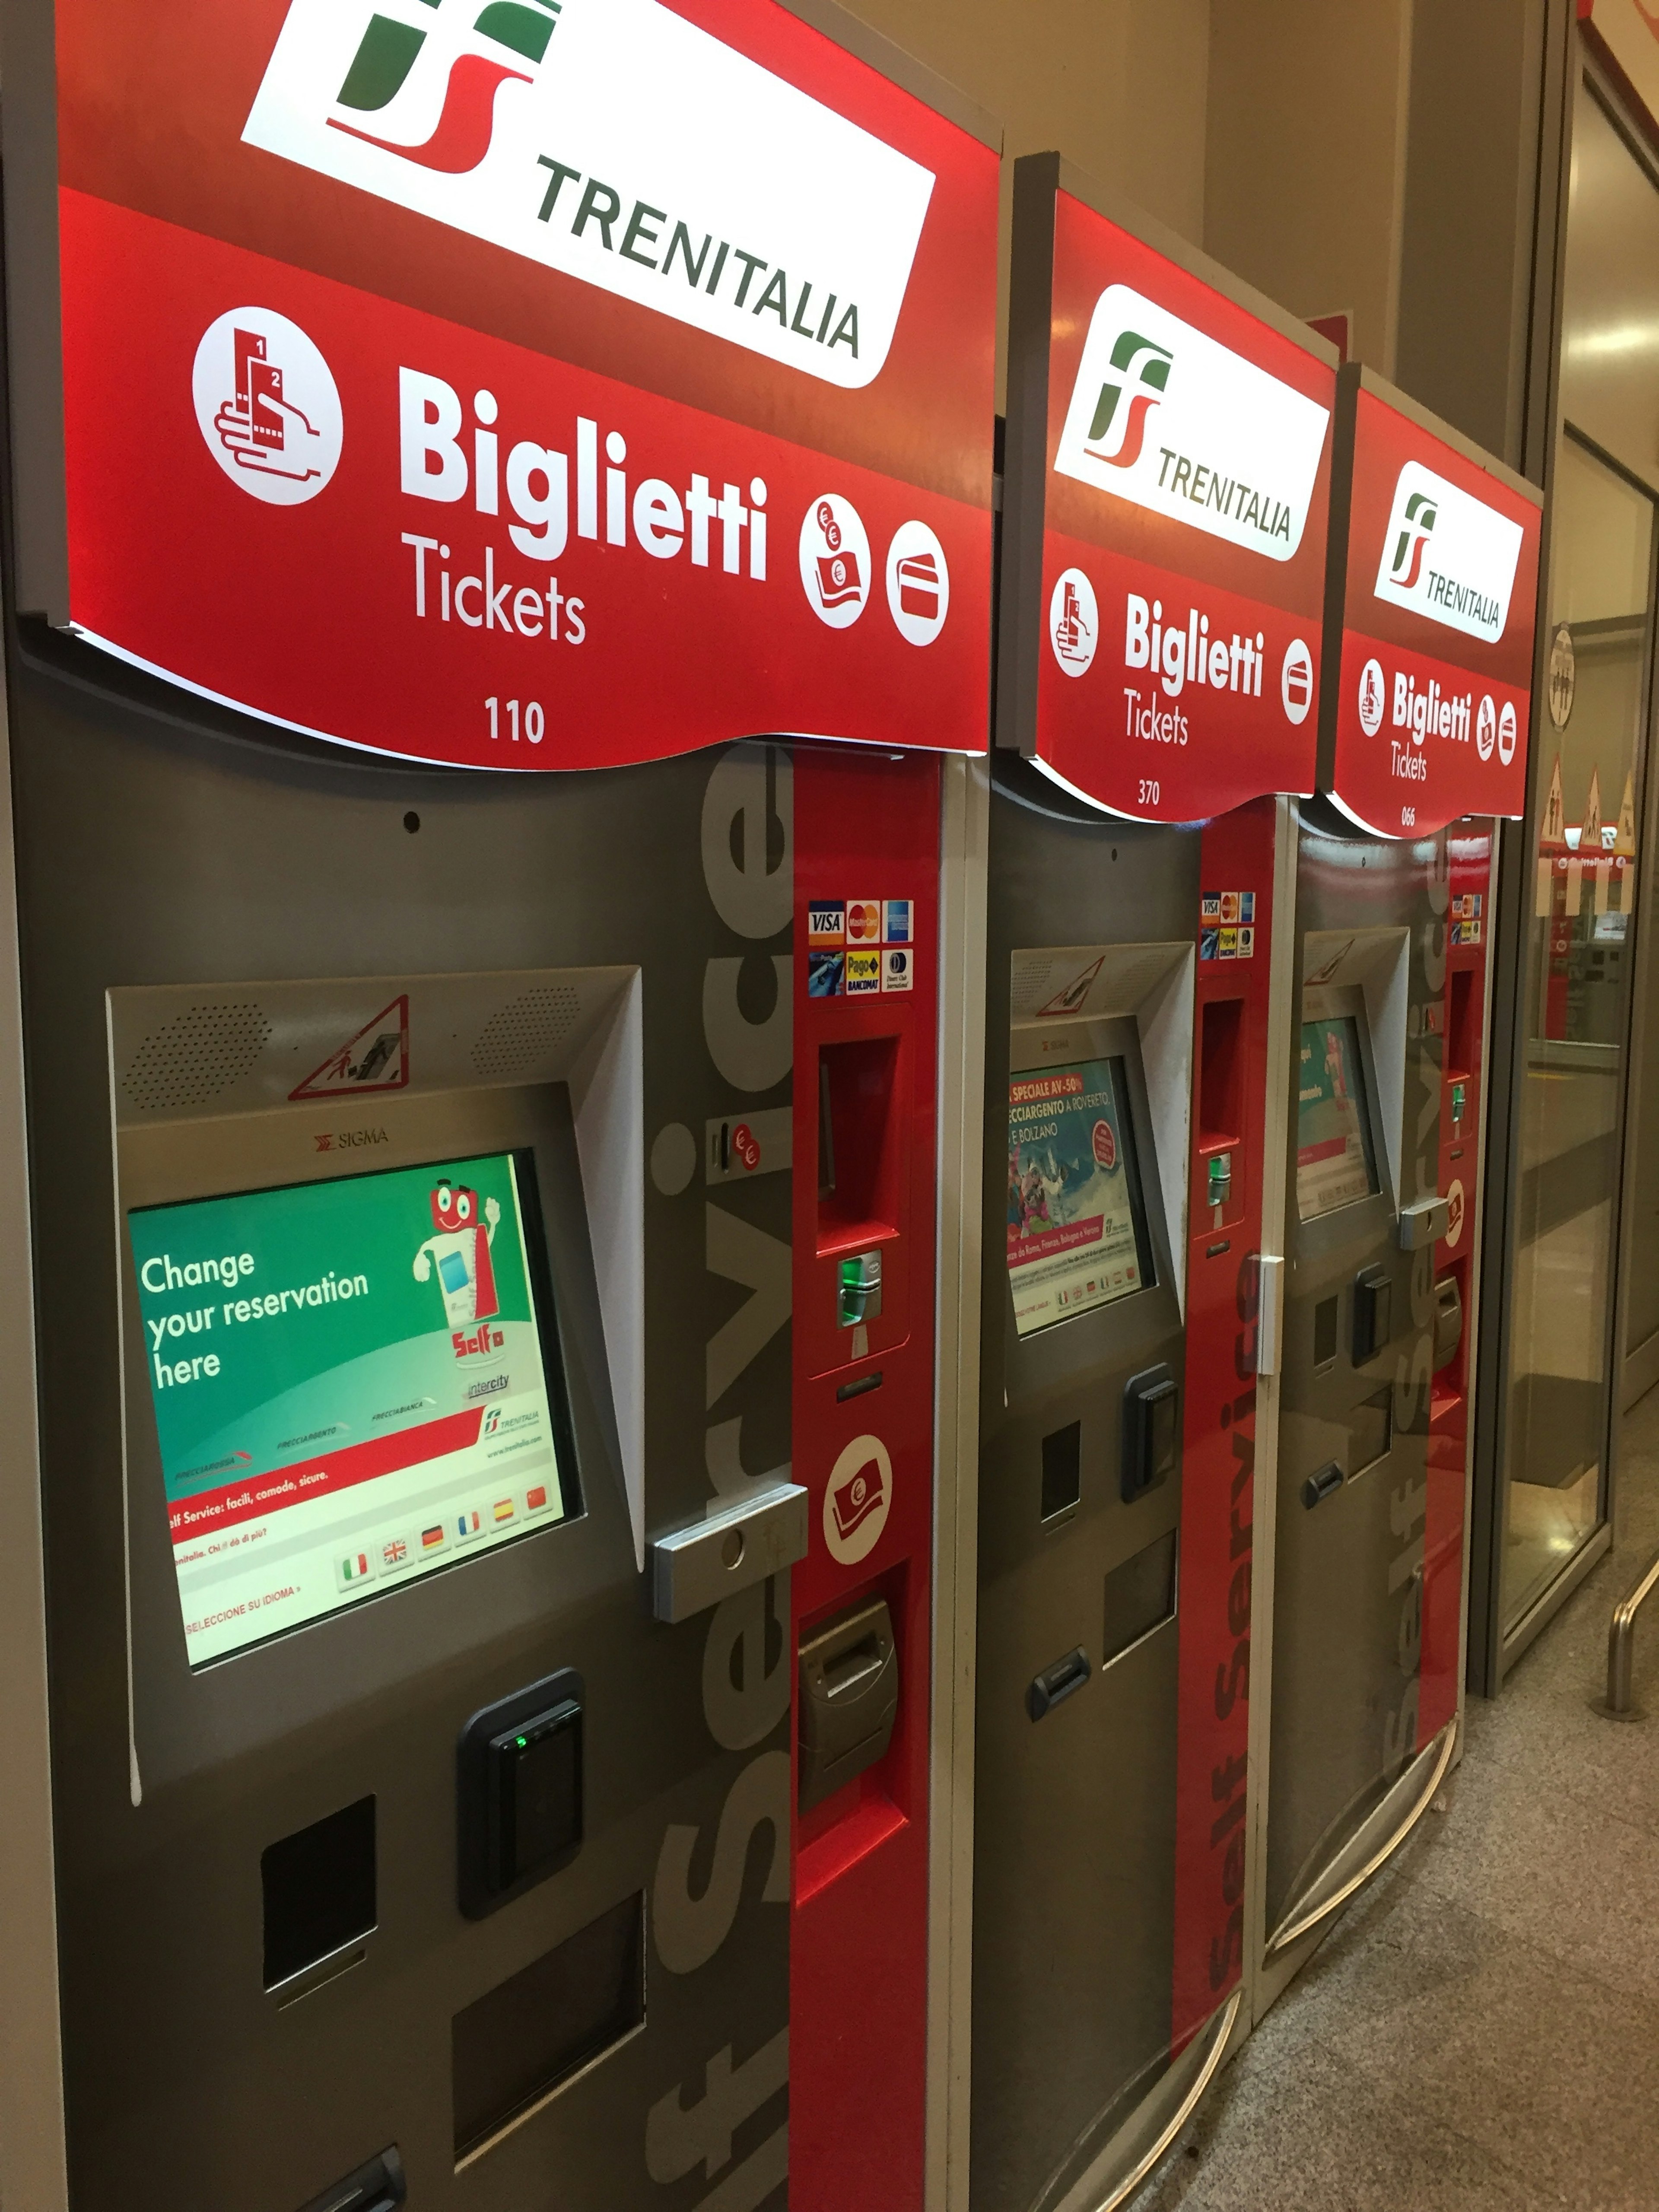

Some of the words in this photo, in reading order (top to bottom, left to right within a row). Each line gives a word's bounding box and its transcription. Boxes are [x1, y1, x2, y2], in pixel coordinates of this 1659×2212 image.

[537, 154, 858, 359] TRENITALIA
[398, 365, 767, 582] Biglietti
[1158, 447, 1290, 542] TRENITALIA
[401, 532, 586, 645] Tickets
[1427, 570, 1499, 628] TRENITALIA
[1125, 593, 1264, 697] Biglietti
[484, 696, 545, 744] 110
[1123, 688, 1188, 746] Tickets
[1392, 671, 1471, 746] Biglietti
[1391, 741, 1427, 781] Tickets
[1138, 779, 1160, 806] 370
[1401, 806, 1416, 826] 066
[812, 913, 840, 931] VISA
[1204, 901, 1218, 914] VISA
[848, 956, 870, 977] Pago
[848, 979, 879, 991] BANCOMAT
[1012, 1081, 1050, 1102] SPECIALE
[1065, 1105, 1072, 1113] A
[338, 1127, 388, 1148] SIGMA
[1011, 1130, 1018, 1145] E
[1019, 1122, 1058, 1144] BOLZANO
[141, 1253, 255, 1293] Change
[147, 1306, 215, 1351] your
[223, 1271, 369, 1325] reservation
[153, 1353, 220, 1389] here
[468, 1375, 509, 1397] intercity
[372, 1402, 423, 1421] FRECCIABIANCA
[501, 1411, 539, 1429] TRENITALIA
[183, 1504, 225, 1524] Service:
[226, 1491, 254, 1510] facili,
[255, 1479, 297, 1501] comode,
[299, 1471, 328, 1487] sicure.
[208, 1544, 220, 1554] Chi
[242, 1534, 249, 1543] di
[185, 1604, 246, 1635] SELECCIONE
[248, 1599, 261, 1611] SU
[262, 1586, 295, 1606] IDIOMA
